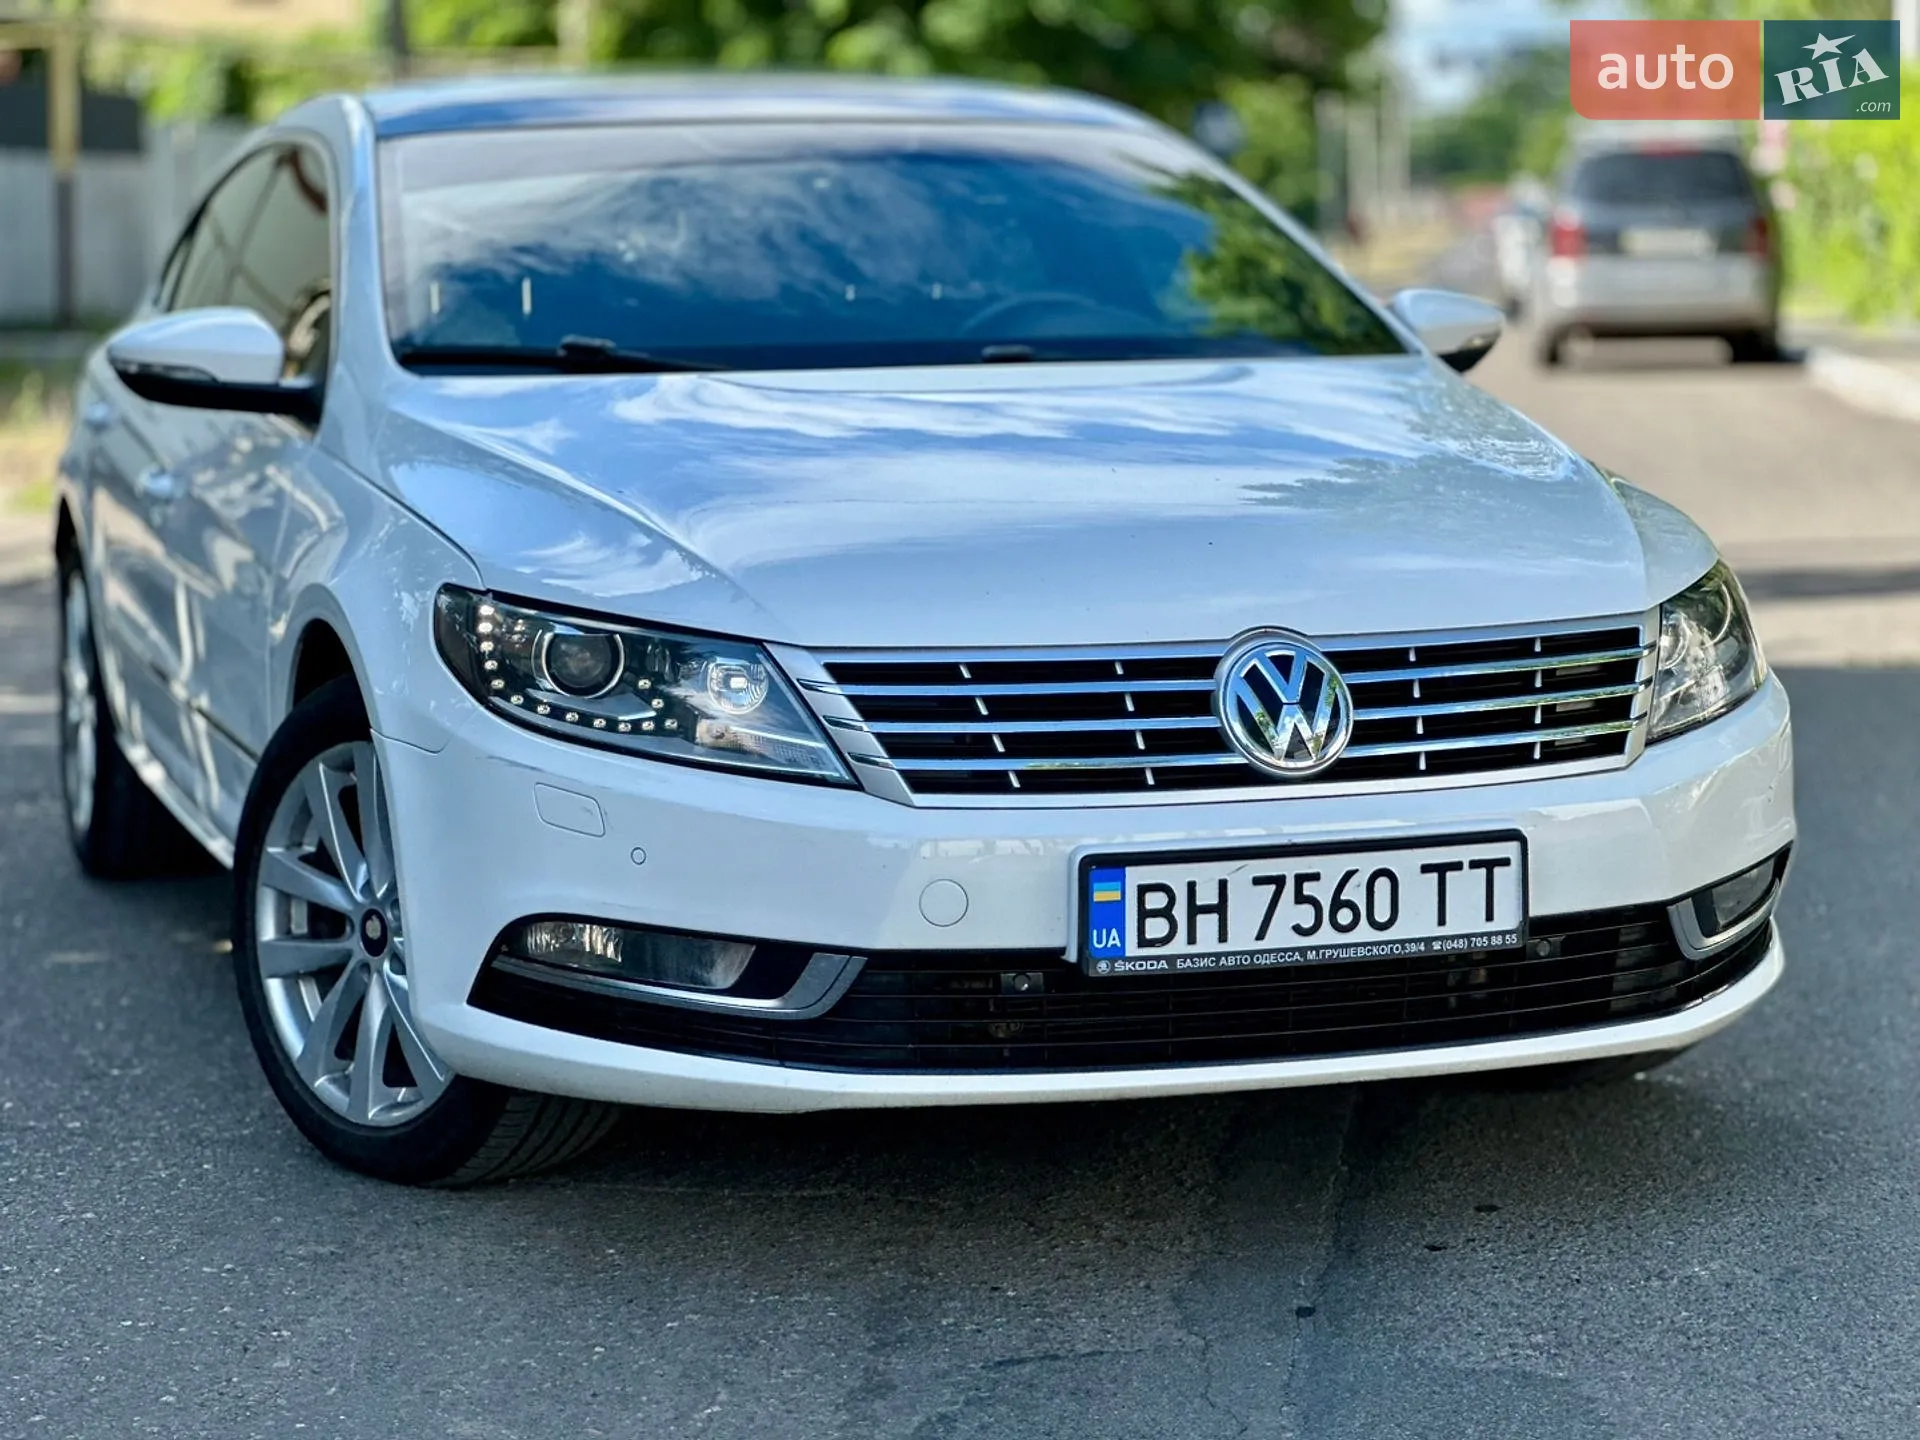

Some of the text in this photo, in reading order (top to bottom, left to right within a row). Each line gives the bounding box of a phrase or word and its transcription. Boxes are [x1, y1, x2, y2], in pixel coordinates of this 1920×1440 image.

[1135, 856, 1511, 949] BH 7560 TT
[1092, 927, 1121, 950] UA
[1176, 956, 1216, 969] БАЗИС
[1218, 954, 1251, 967] АВТО
[1252, 952, 1304, 965] ОДЕССА,
[1470, 936, 1489, 947] 705
[1490, 935, 1503, 946] 88
[1505, 933, 1518, 945] 55
